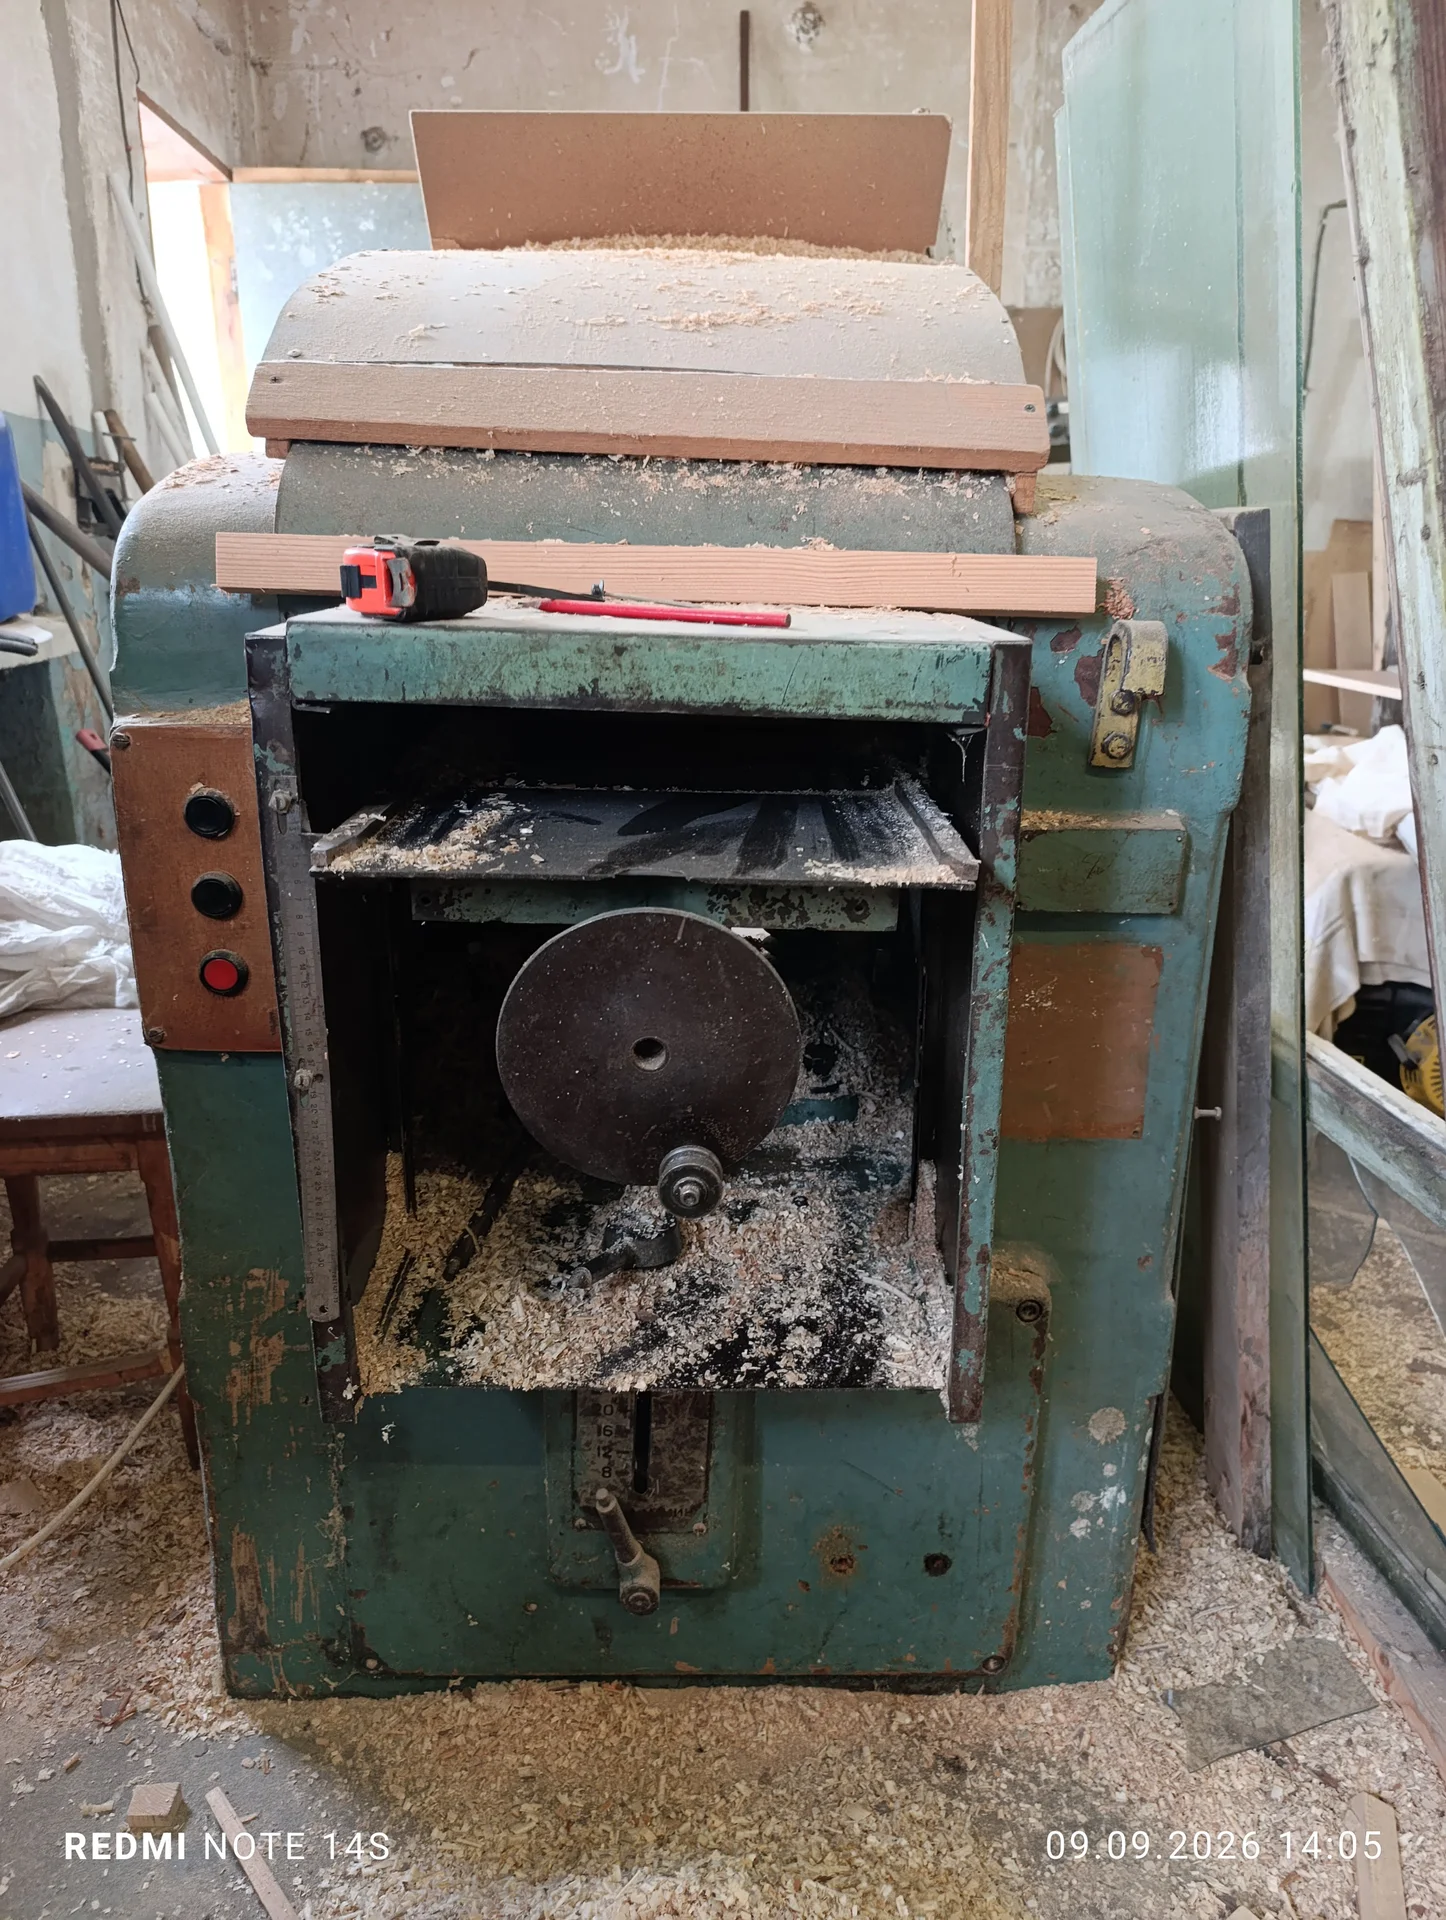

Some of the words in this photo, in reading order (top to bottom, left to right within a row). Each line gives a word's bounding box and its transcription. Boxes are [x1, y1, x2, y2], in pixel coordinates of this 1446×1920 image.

[298, 946, 306, 955] 10
[301, 980, 308, 988] 12
[302, 996, 310, 1005] 13
[304, 1012, 311, 1021] 14
[305, 1028, 312, 1036] 15
[306, 1044, 314, 1052] 16
[311, 1119, 318, 1129] 21
[314, 1166, 322, 1176] 24
[315, 1181, 322, 1191] 25
[316, 1212, 324, 1221] 27
[316, 1227, 324, 1237] 28
[317, 1242, 325, 1252] 29
[597, 1425, 613, 1437] 16
[597, 1446, 612, 1458] 12
[601, 1466, 612, 1478] 8
